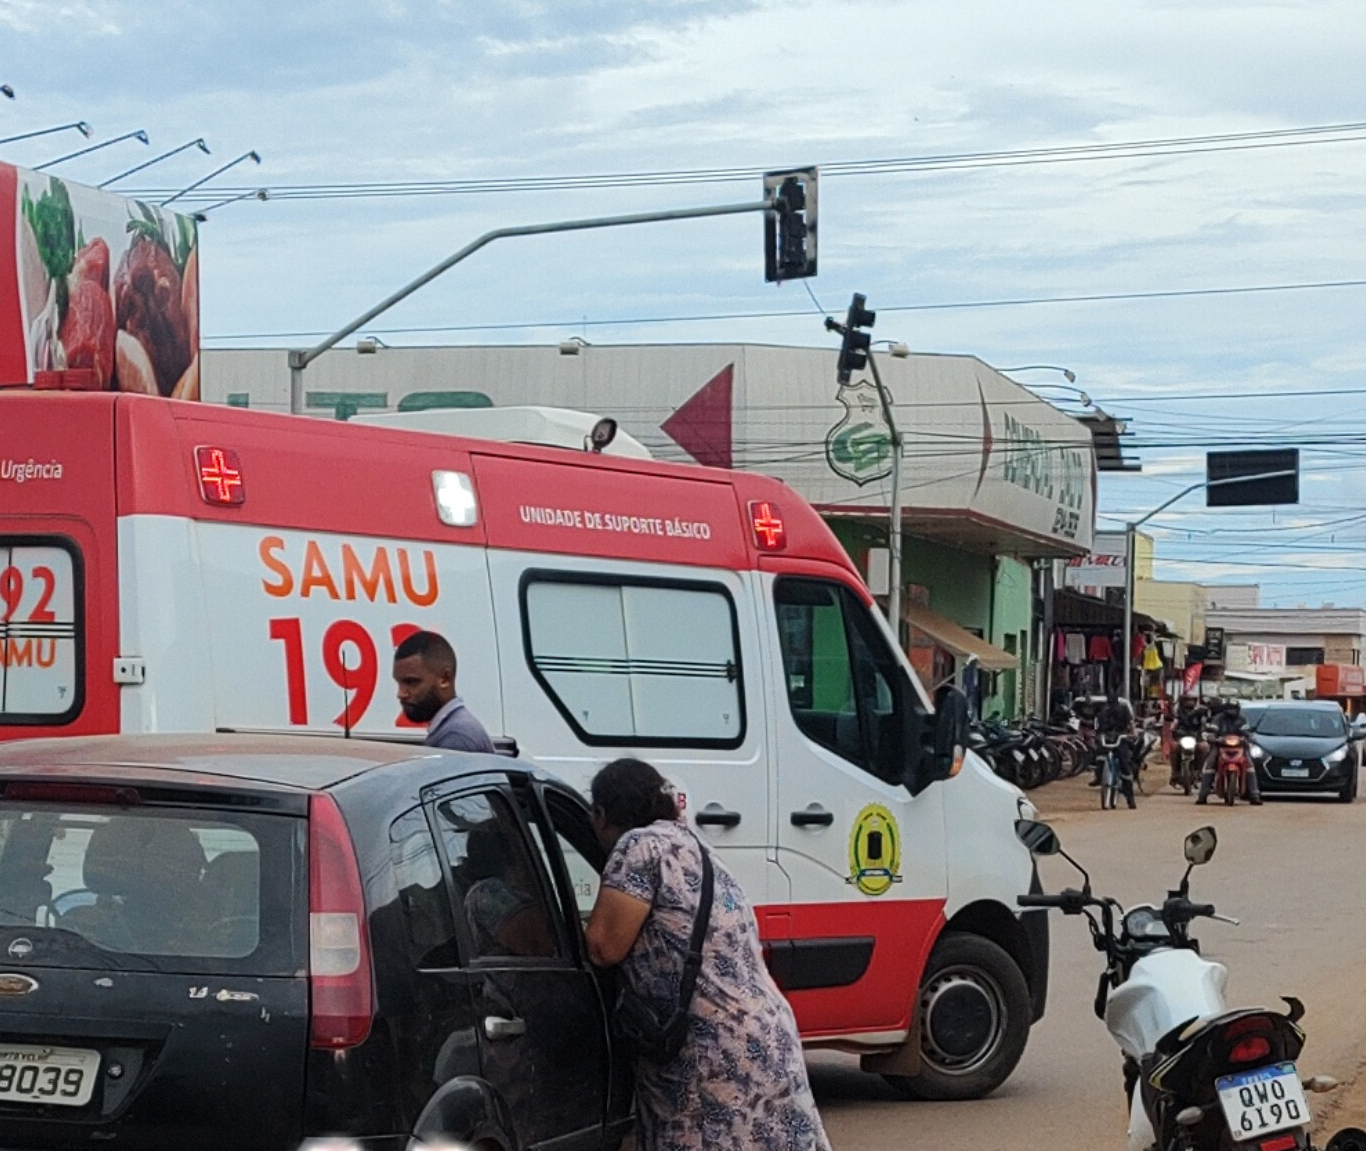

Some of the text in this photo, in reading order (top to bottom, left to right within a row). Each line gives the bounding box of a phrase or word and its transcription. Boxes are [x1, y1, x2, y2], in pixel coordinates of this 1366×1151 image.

[1, 459, 63, 483] Urgência
[520, 505, 711, 540] UNIDADE DE SUPORTE BÁSICO
[258, 535, 439, 607] SAMU
[1240, 1099, 1301, 1131] 6190
